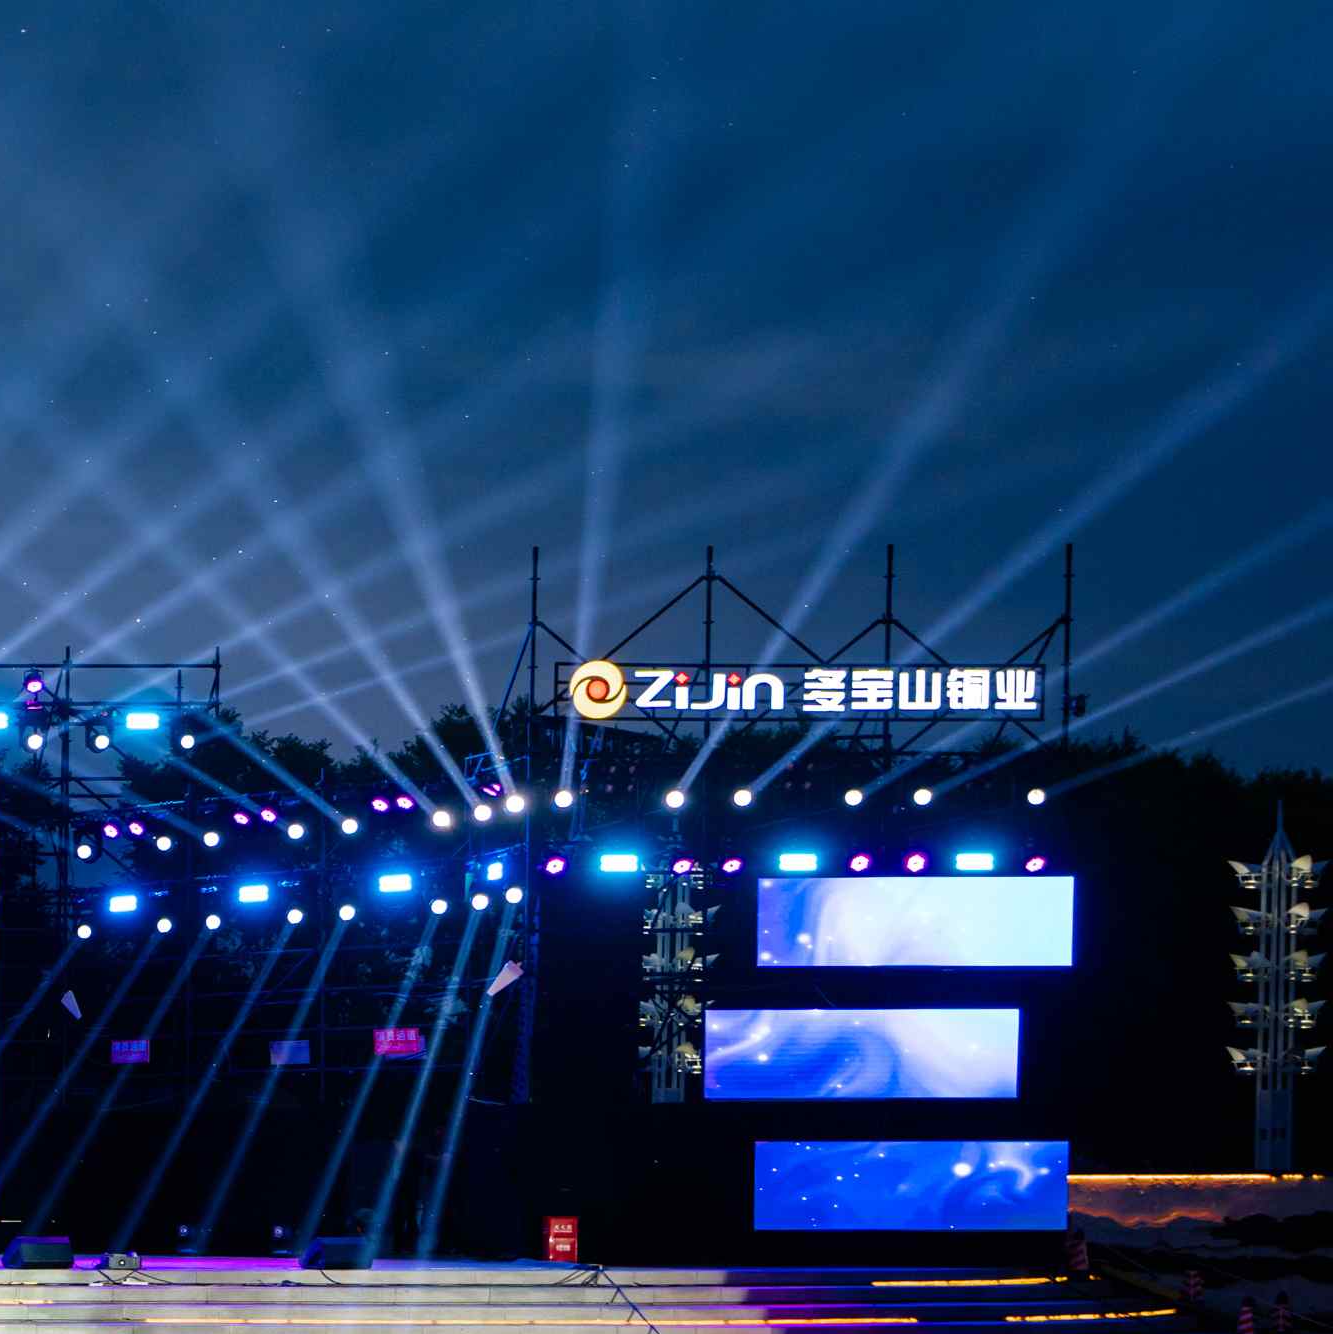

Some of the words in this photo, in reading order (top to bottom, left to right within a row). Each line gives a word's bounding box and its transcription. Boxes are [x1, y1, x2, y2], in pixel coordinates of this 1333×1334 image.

[803, 668, 1037, 712] 多宝山铜业
